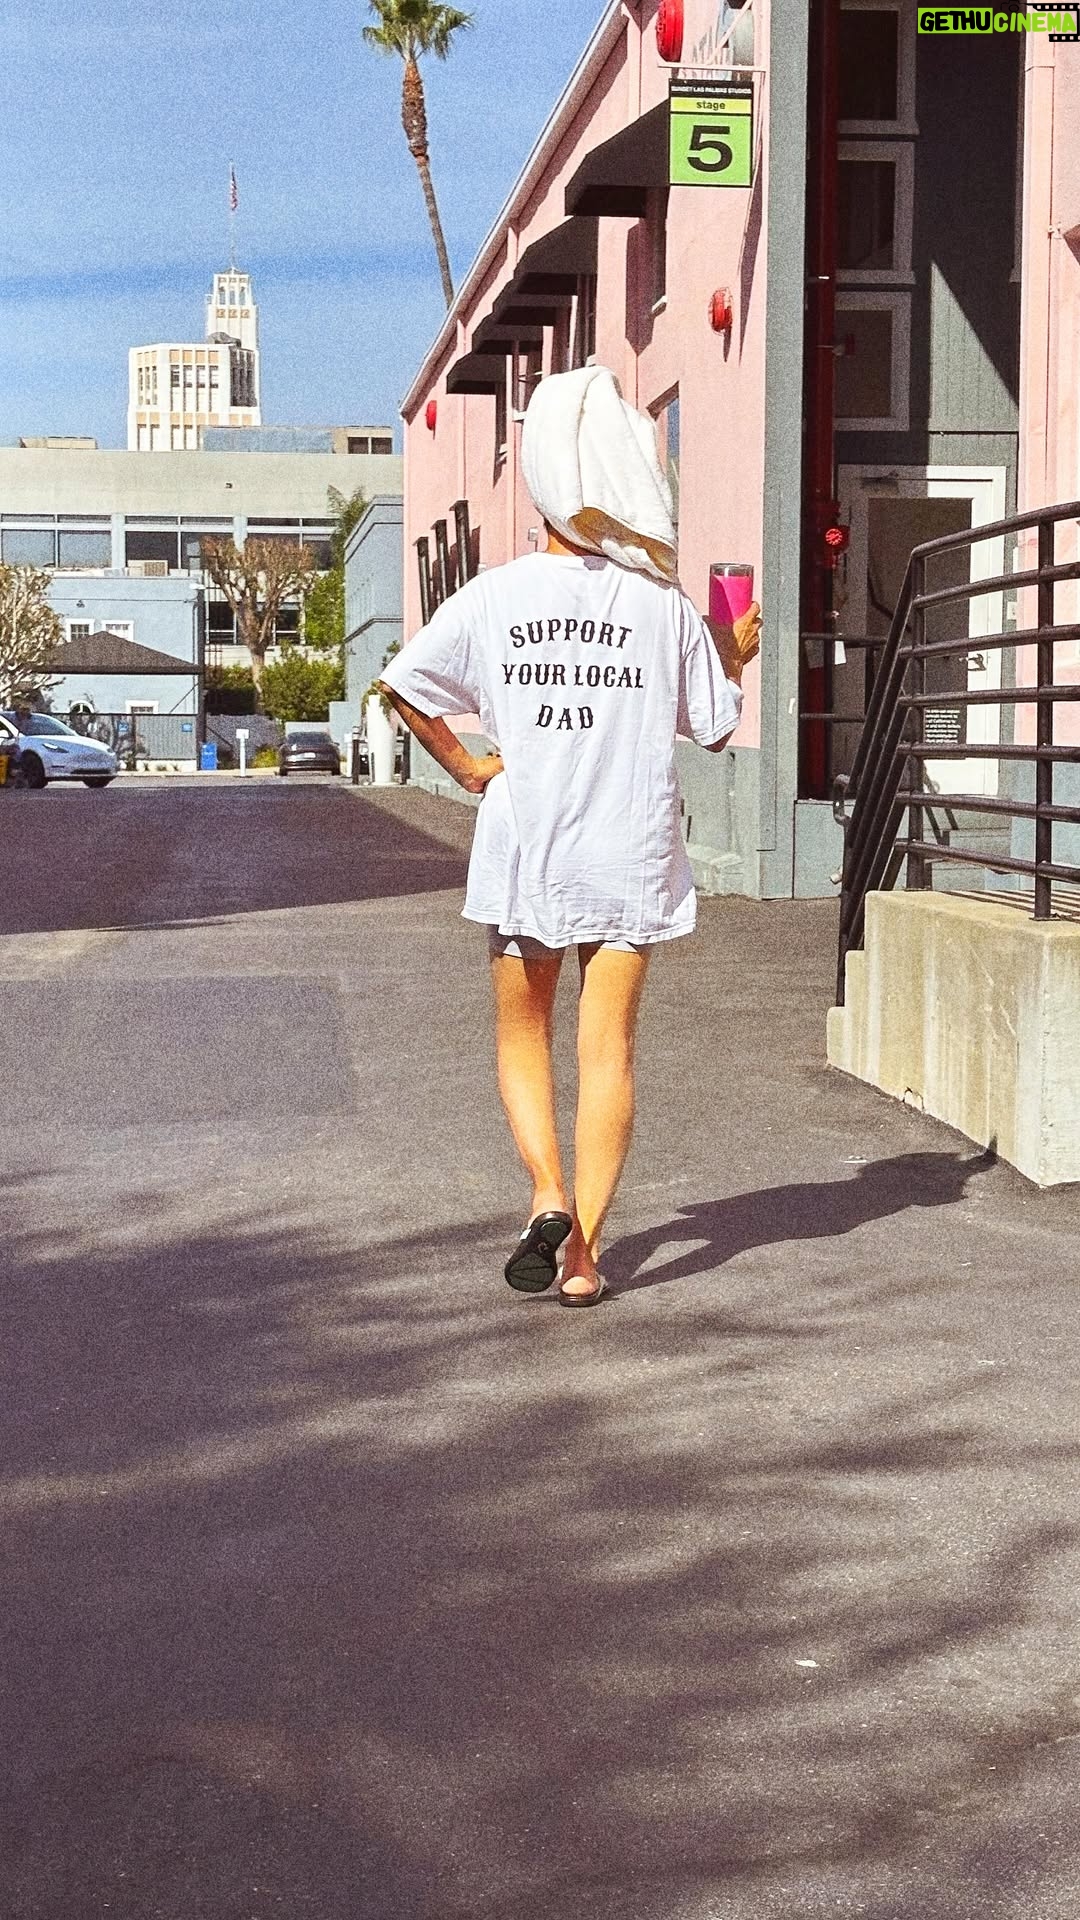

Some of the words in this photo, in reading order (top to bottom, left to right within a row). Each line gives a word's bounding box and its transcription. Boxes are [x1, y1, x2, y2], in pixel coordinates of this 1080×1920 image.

[696, 101, 726, 111] stage
[687, 124, 733, 173] 5
[509, 617, 633, 649] SUPPORT
[501, 663, 567, 686] YOUR
[573, 664, 644, 689] LOCAL
[535, 703, 594, 731] DAD
